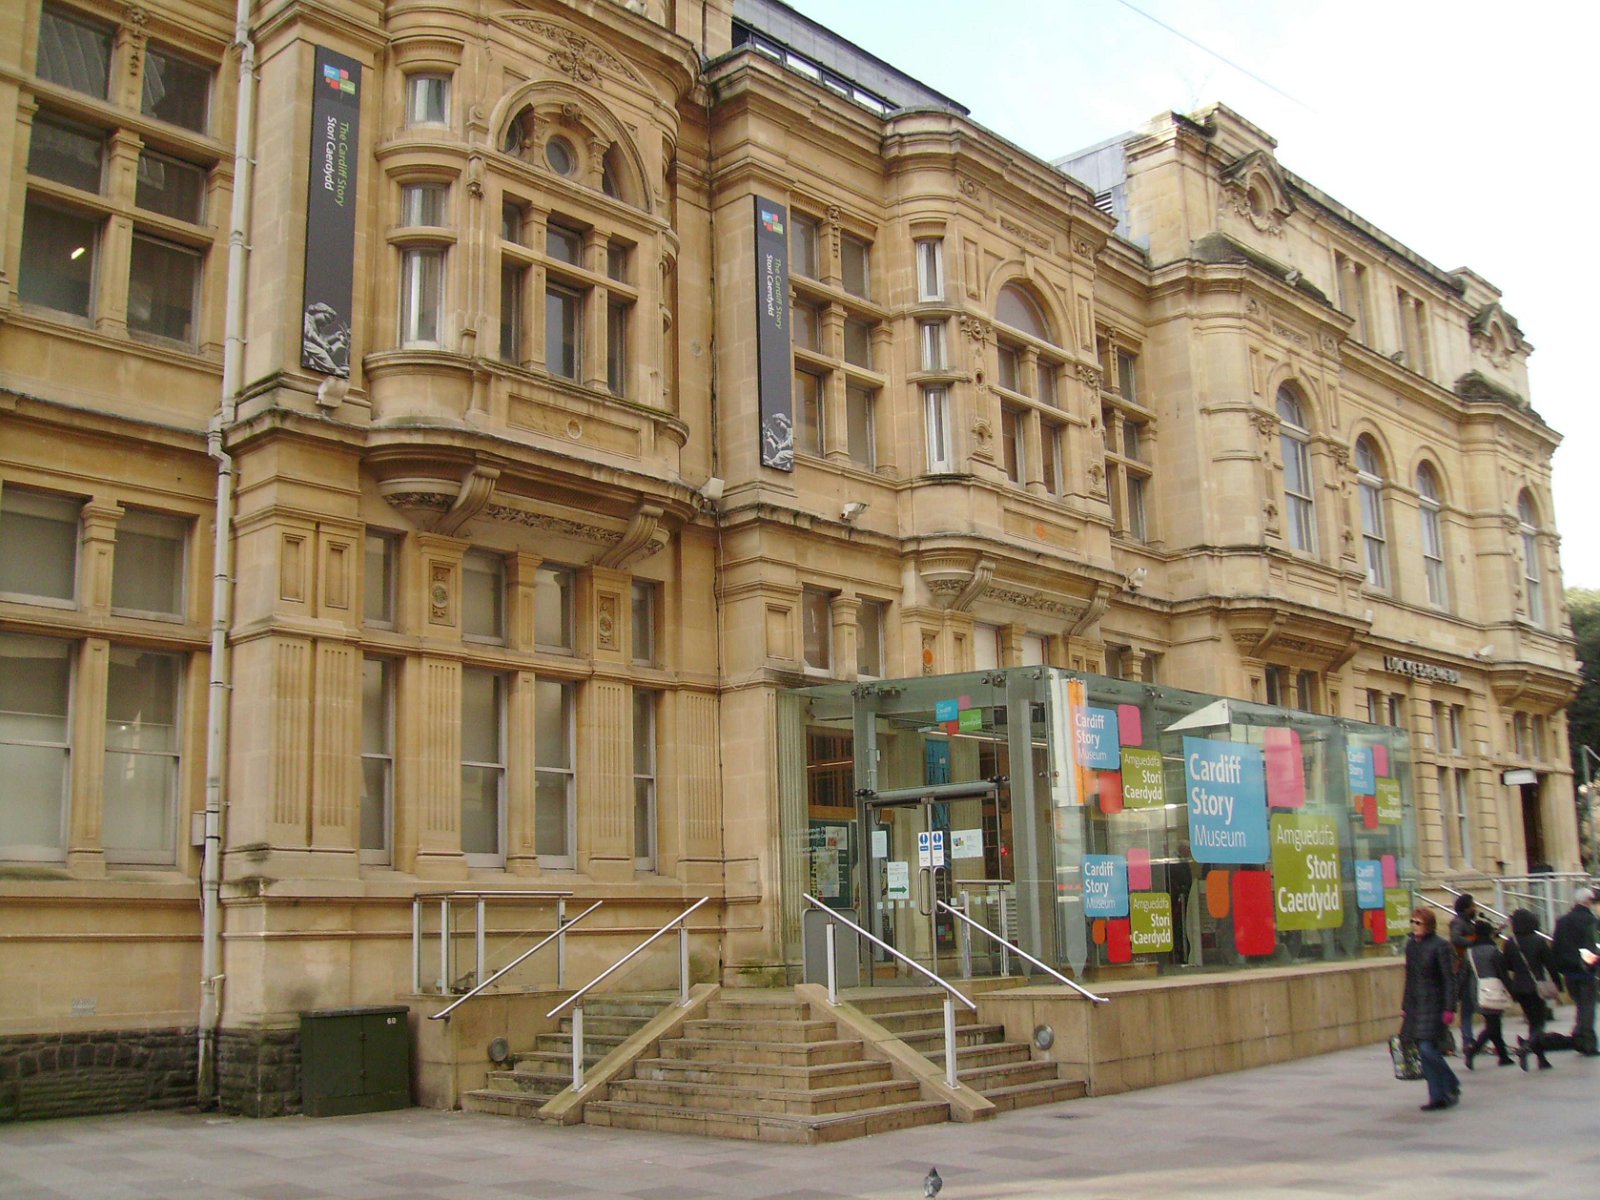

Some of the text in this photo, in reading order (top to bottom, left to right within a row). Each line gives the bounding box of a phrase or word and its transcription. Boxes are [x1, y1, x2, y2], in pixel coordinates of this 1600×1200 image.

[323, 116, 337, 191] Stori Caerdydd
[335, 122, 349, 207] The Cardiff Story
[766, 275, 774, 317] Caerdydd
[775, 305, 783, 329] Story
[1075, 713, 1104, 729] Cardiff
[1076, 730, 1100, 749] Story
[1078, 748, 1107, 760] Museum
[1124, 753, 1160, 768] Amgueddfa
[1142, 770, 1161, 784] Stori
[1190, 753, 1241, 784] Cardiff
[1124, 785, 1162, 803] Caerdydd
[1192, 787, 1233, 825] Story
[1194, 825, 1246, 847] Museum
[1277, 824, 1335, 851] Amgueddfa
[1084, 862, 1114, 876] Cardiff
[1306, 854, 1337, 880] Stori
[1085, 879, 1109, 897] Story
[1087, 898, 1115, 909] Museum
[1134, 897, 1169, 912] Amgueddfa
[1278, 885, 1339, 919] Caerdydd
[1151, 913, 1170, 927] Stori
[1133, 929, 1171, 948] Caerdydd
